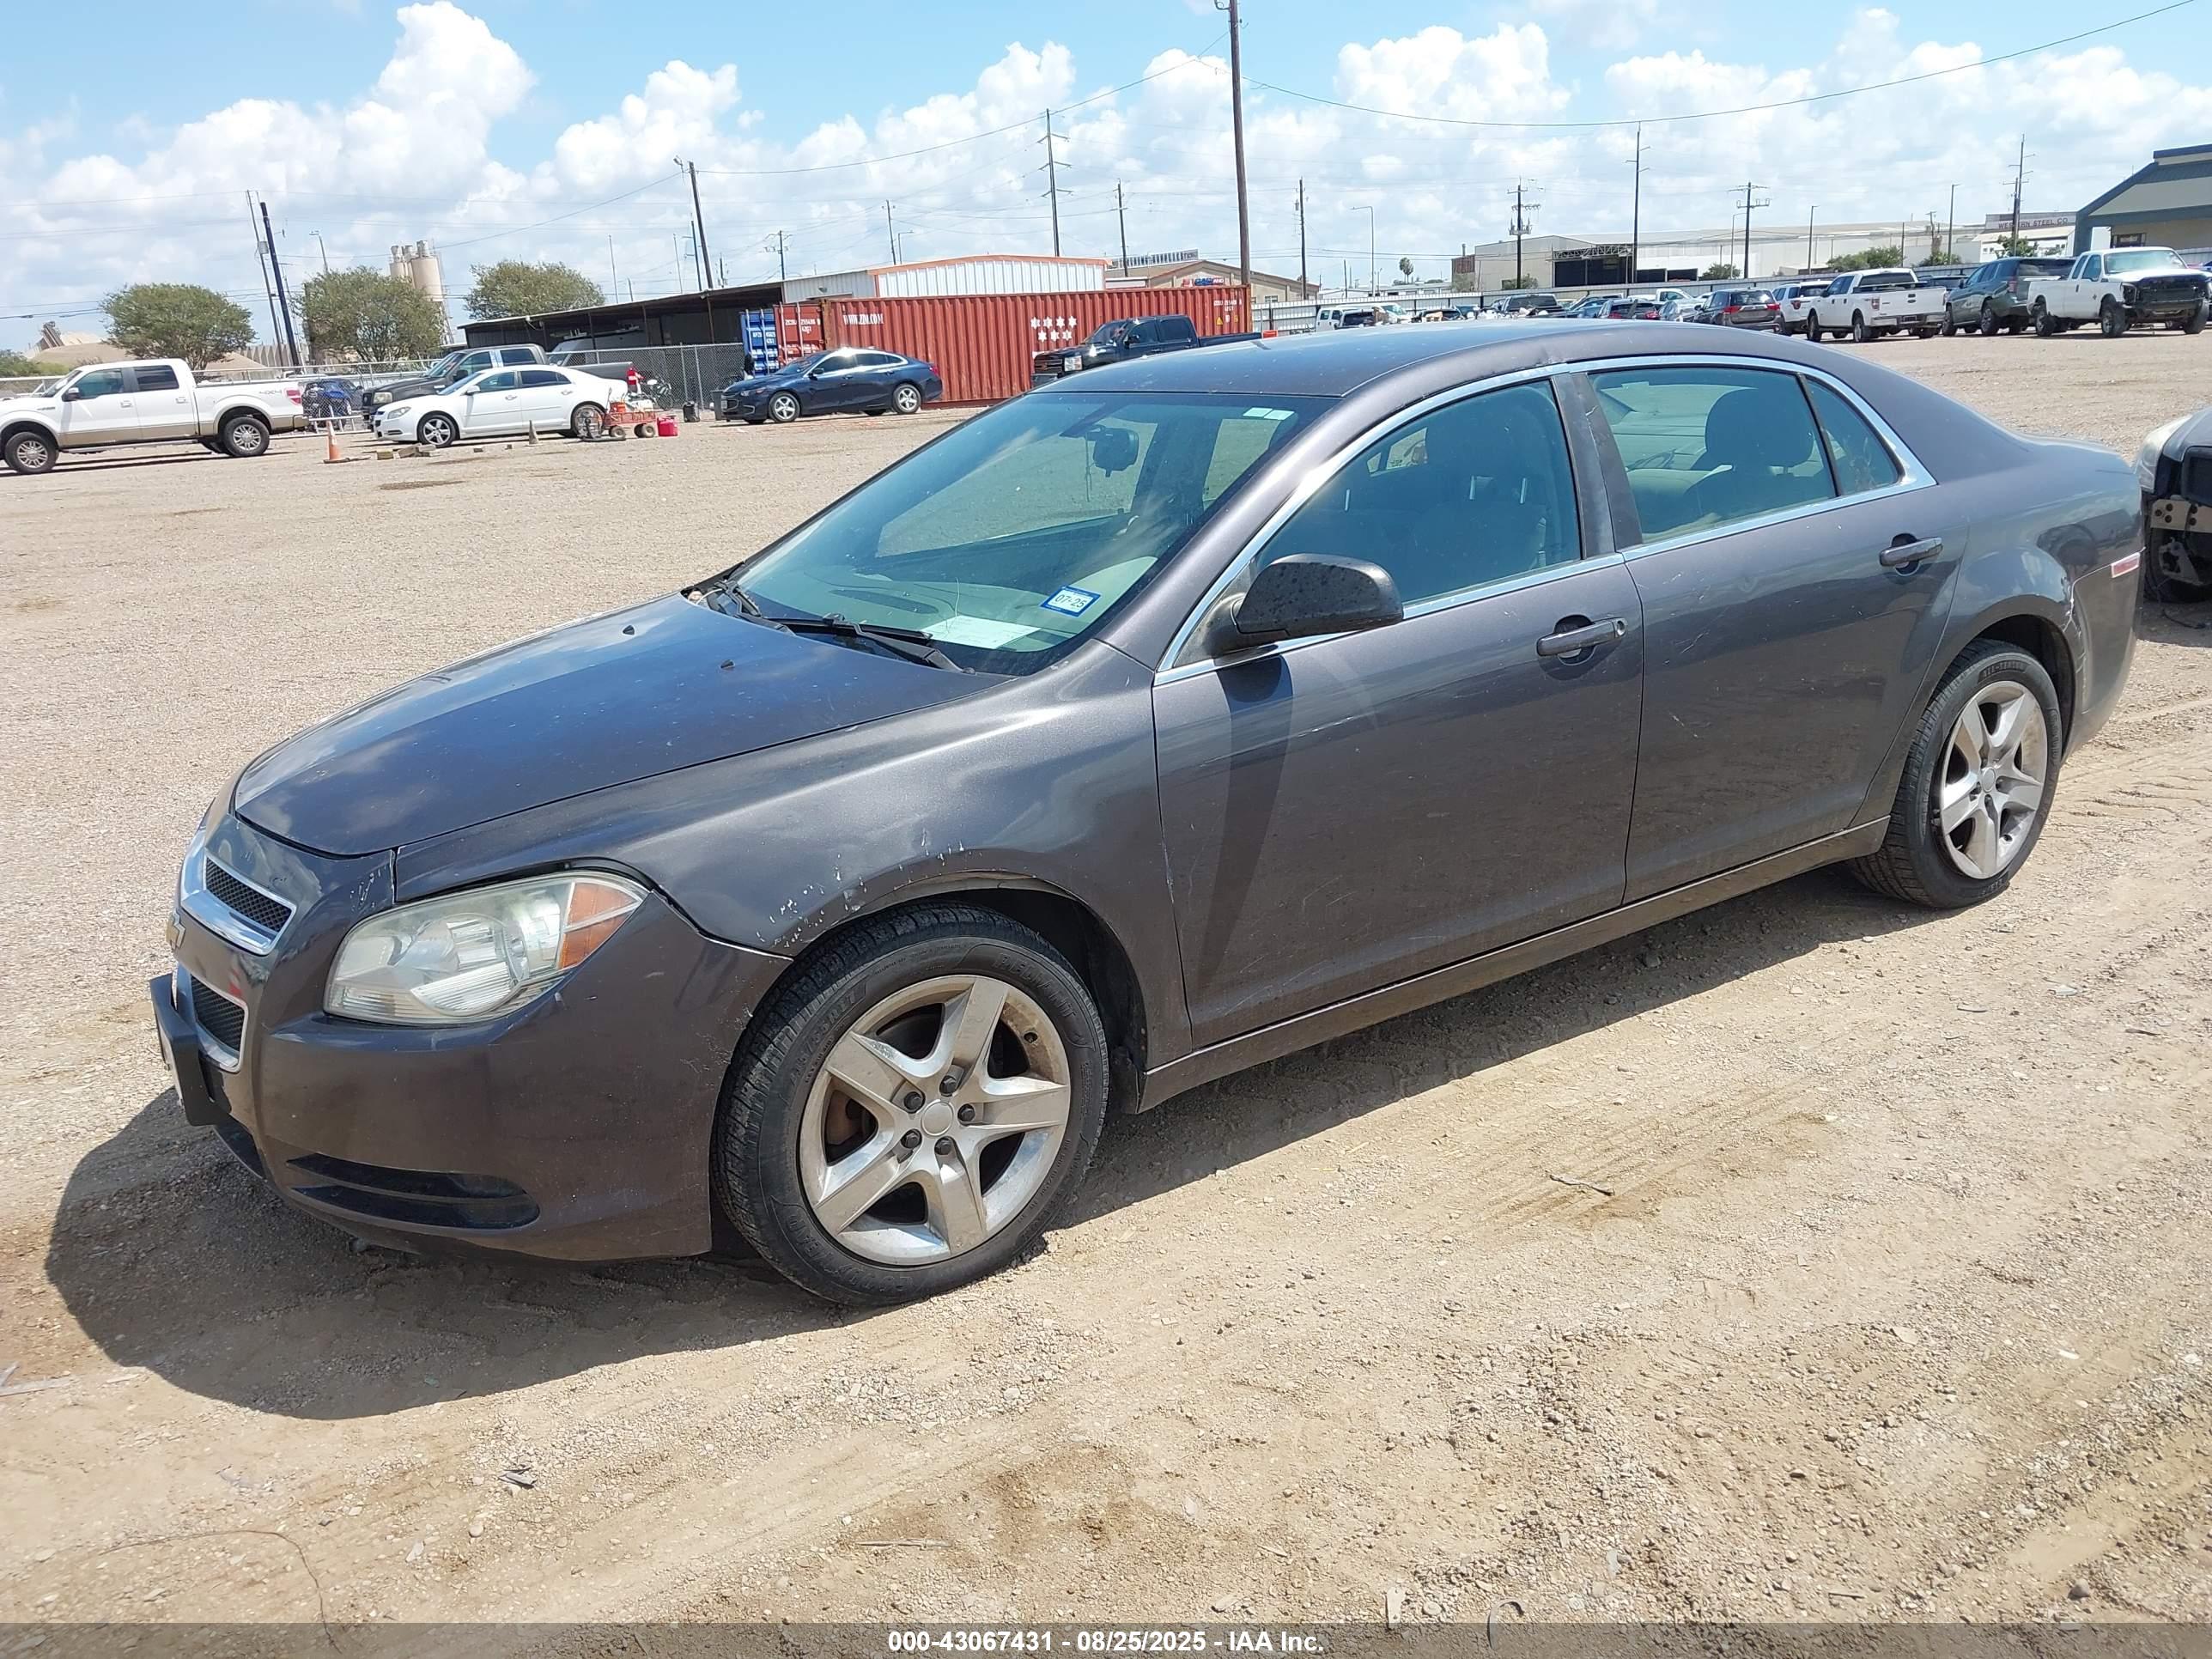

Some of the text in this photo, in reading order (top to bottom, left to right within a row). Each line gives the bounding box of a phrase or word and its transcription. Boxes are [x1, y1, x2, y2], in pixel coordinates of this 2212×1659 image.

[1998, 221, 2030, 229] WESRN
[2057, 217, 2069, 226] CO
[1054, 594, 1087, 608] 07-25
